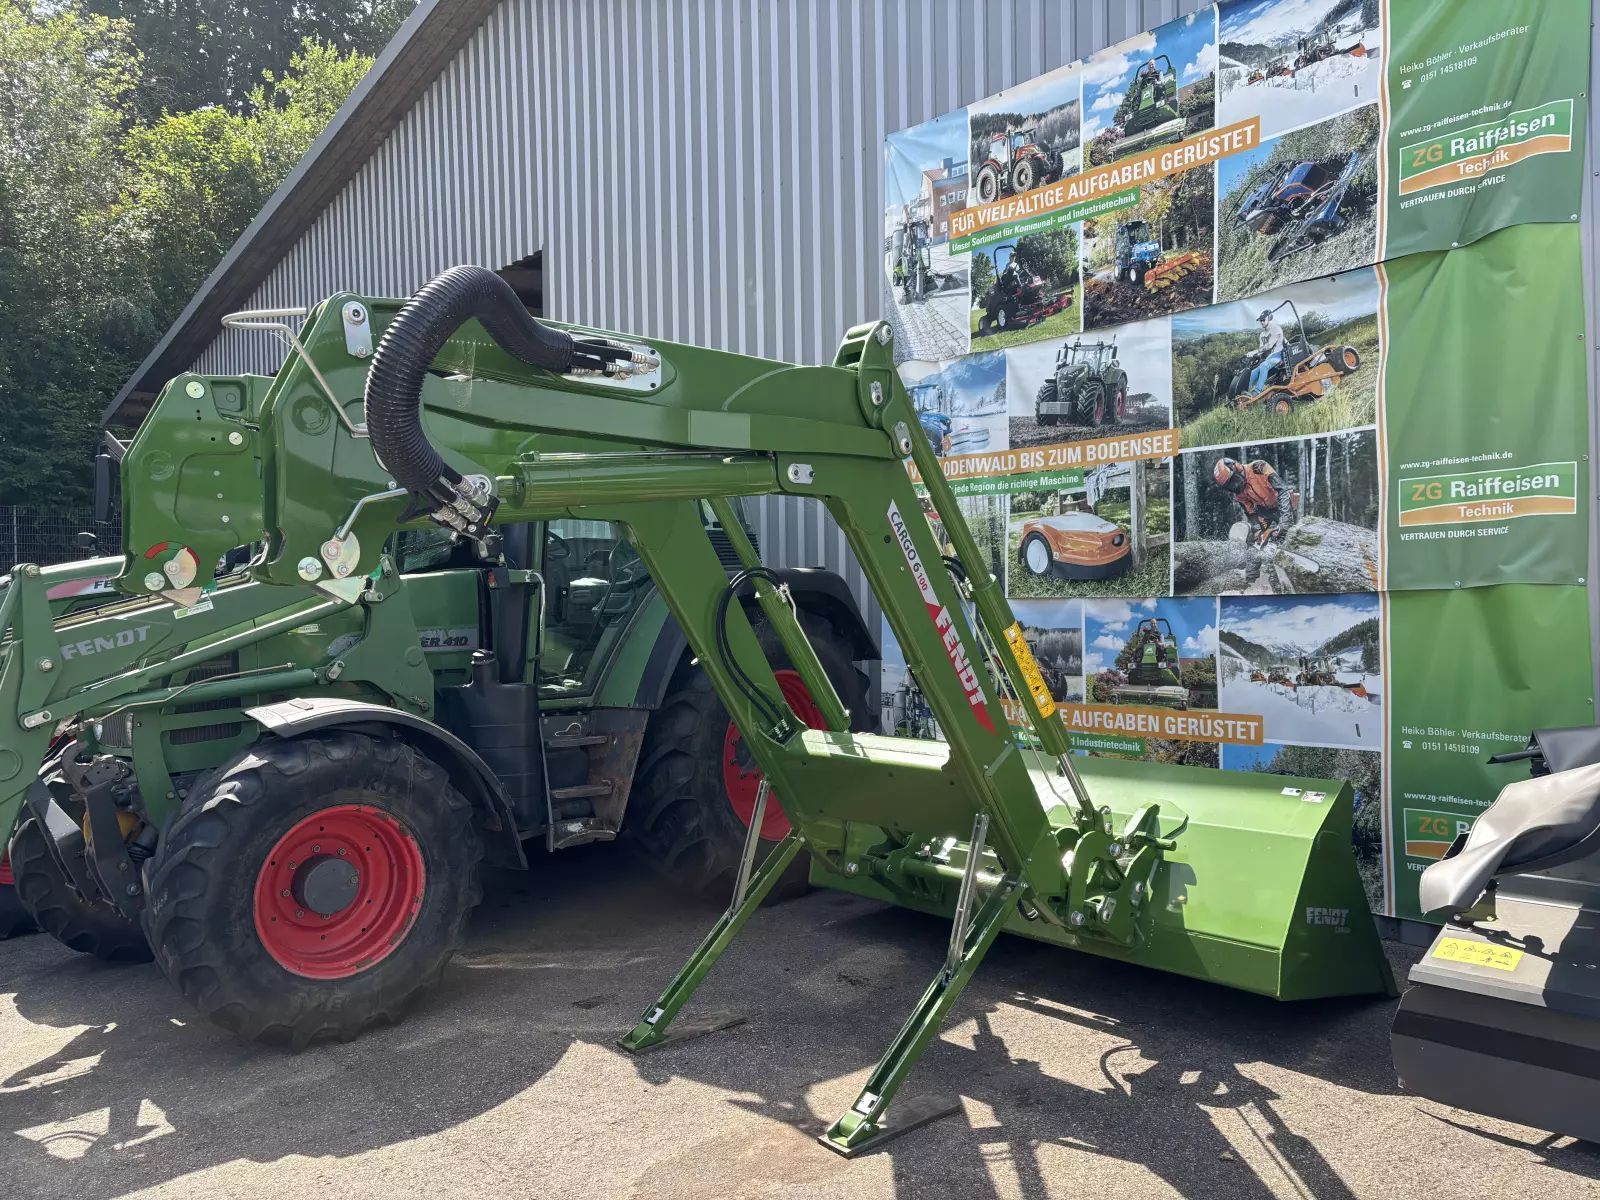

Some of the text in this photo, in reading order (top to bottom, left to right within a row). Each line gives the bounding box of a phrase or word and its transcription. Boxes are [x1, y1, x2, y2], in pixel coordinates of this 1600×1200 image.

[1400, 25, 1529, 75] Heiko Böhler Verkaufsberater
[1420, 56, 1478, 83] 0151 14518109
[1400, 100, 1512, 138] www.zg-raiffeisen-technik.de
[1412, 113, 1555, 167] ZG Raiffeisen
[952, 124, 1256, 235] FÜR VIELFÄLTIGE AUFGABEN GERÜSTET
[1400, 174, 1506, 210] VERTRAUEN DURCH RVICE
[952, 193, 1136, 252] Unser Sortiment für Kommunal- und Industrietechnik
[944, 434, 1173, 477] ODENWALD BIS ZUM BODENSEE
[1400, 451, 1513, 470] www.zg-raiffeisen-technik.de
[954, 474, 1079, 495] jede Region die richtige Maschine
[1411, 474, 1560, 501] ZG Raiffeisen
[1458, 502, 1515, 518] Technik
[890, 511, 917, 561] CARGO
[1400, 526, 1510, 541] VERTRAUEN DURCH SERVICE
[61, 624, 151, 661] FENDT
[935, 604, 988, 705] FENDT
[1072, 710, 1160, 732] AUFGABEN
[1165, 714, 1259, 740] GERÜSTET
[1402, 726, 1531, 742] Heiko Böhler Verkaufsberater
[1076, 738, 1140, 752] Industrietechnik
[1422, 741, 1480, 754] 0151 14518109
[1404, 792, 1493, 807] www.zg-raiffeisen-tech
[1418, 816, 1449, 836] ZG
[1306, 906, 1349, 926] FENDT
